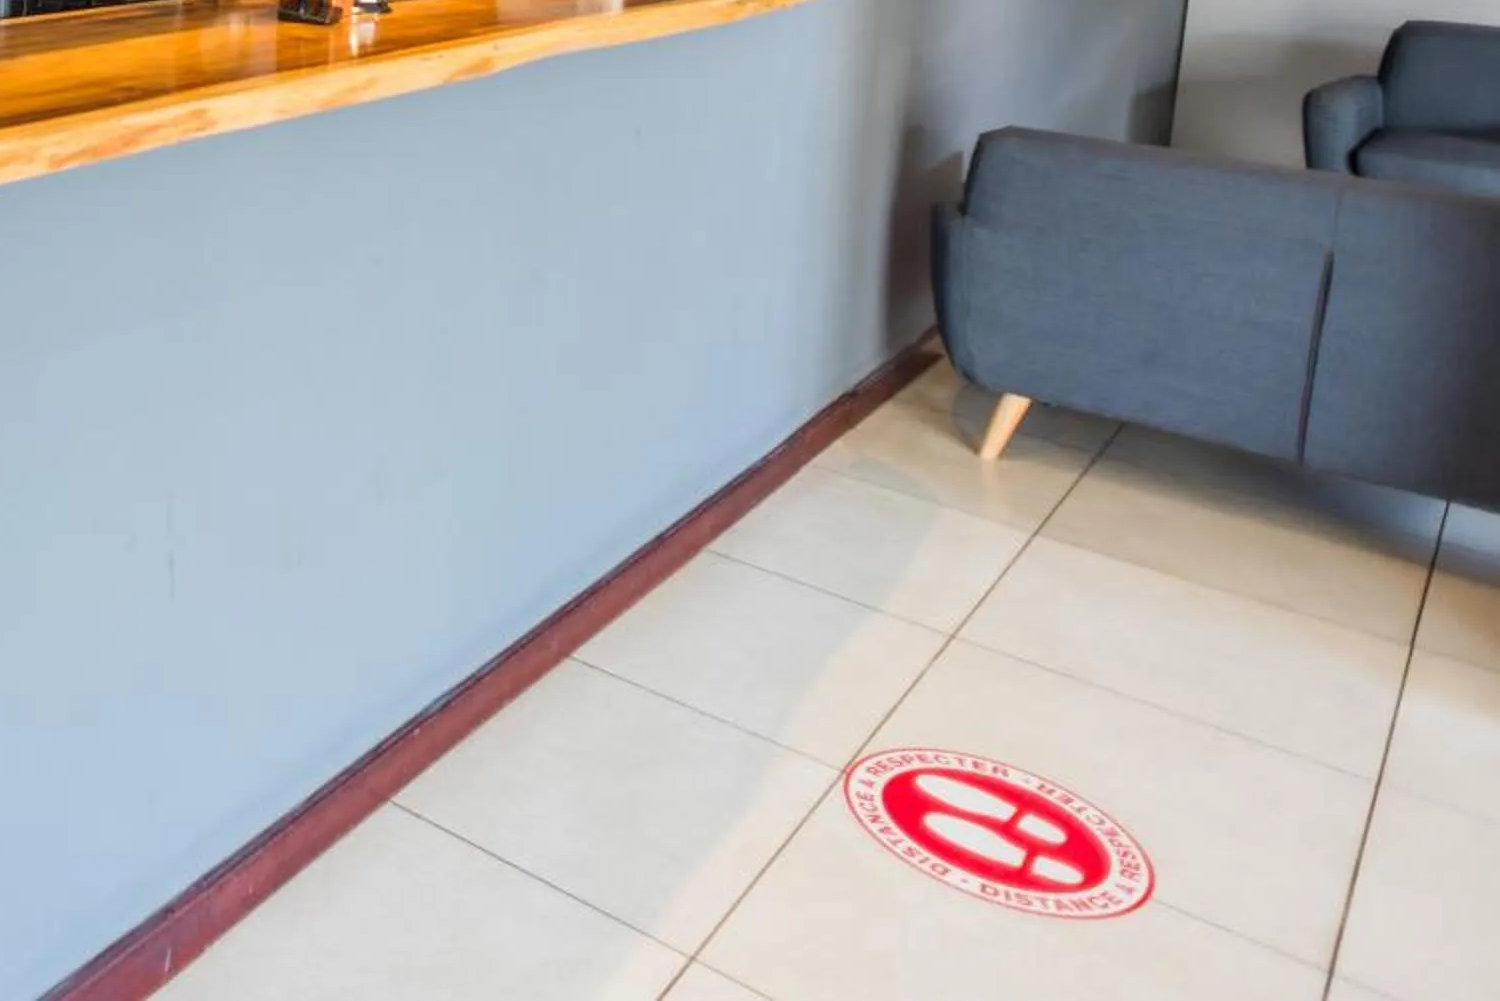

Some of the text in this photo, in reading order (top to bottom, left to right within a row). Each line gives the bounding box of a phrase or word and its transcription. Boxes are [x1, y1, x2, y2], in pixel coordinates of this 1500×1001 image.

[866, 753, 1011, 778] RESPECTER
[855, 790, 952, 876] DISTANCE
[1036, 782, 1142, 883] RESPECTER
[979, 881, 1124, 912] DISTANCE
